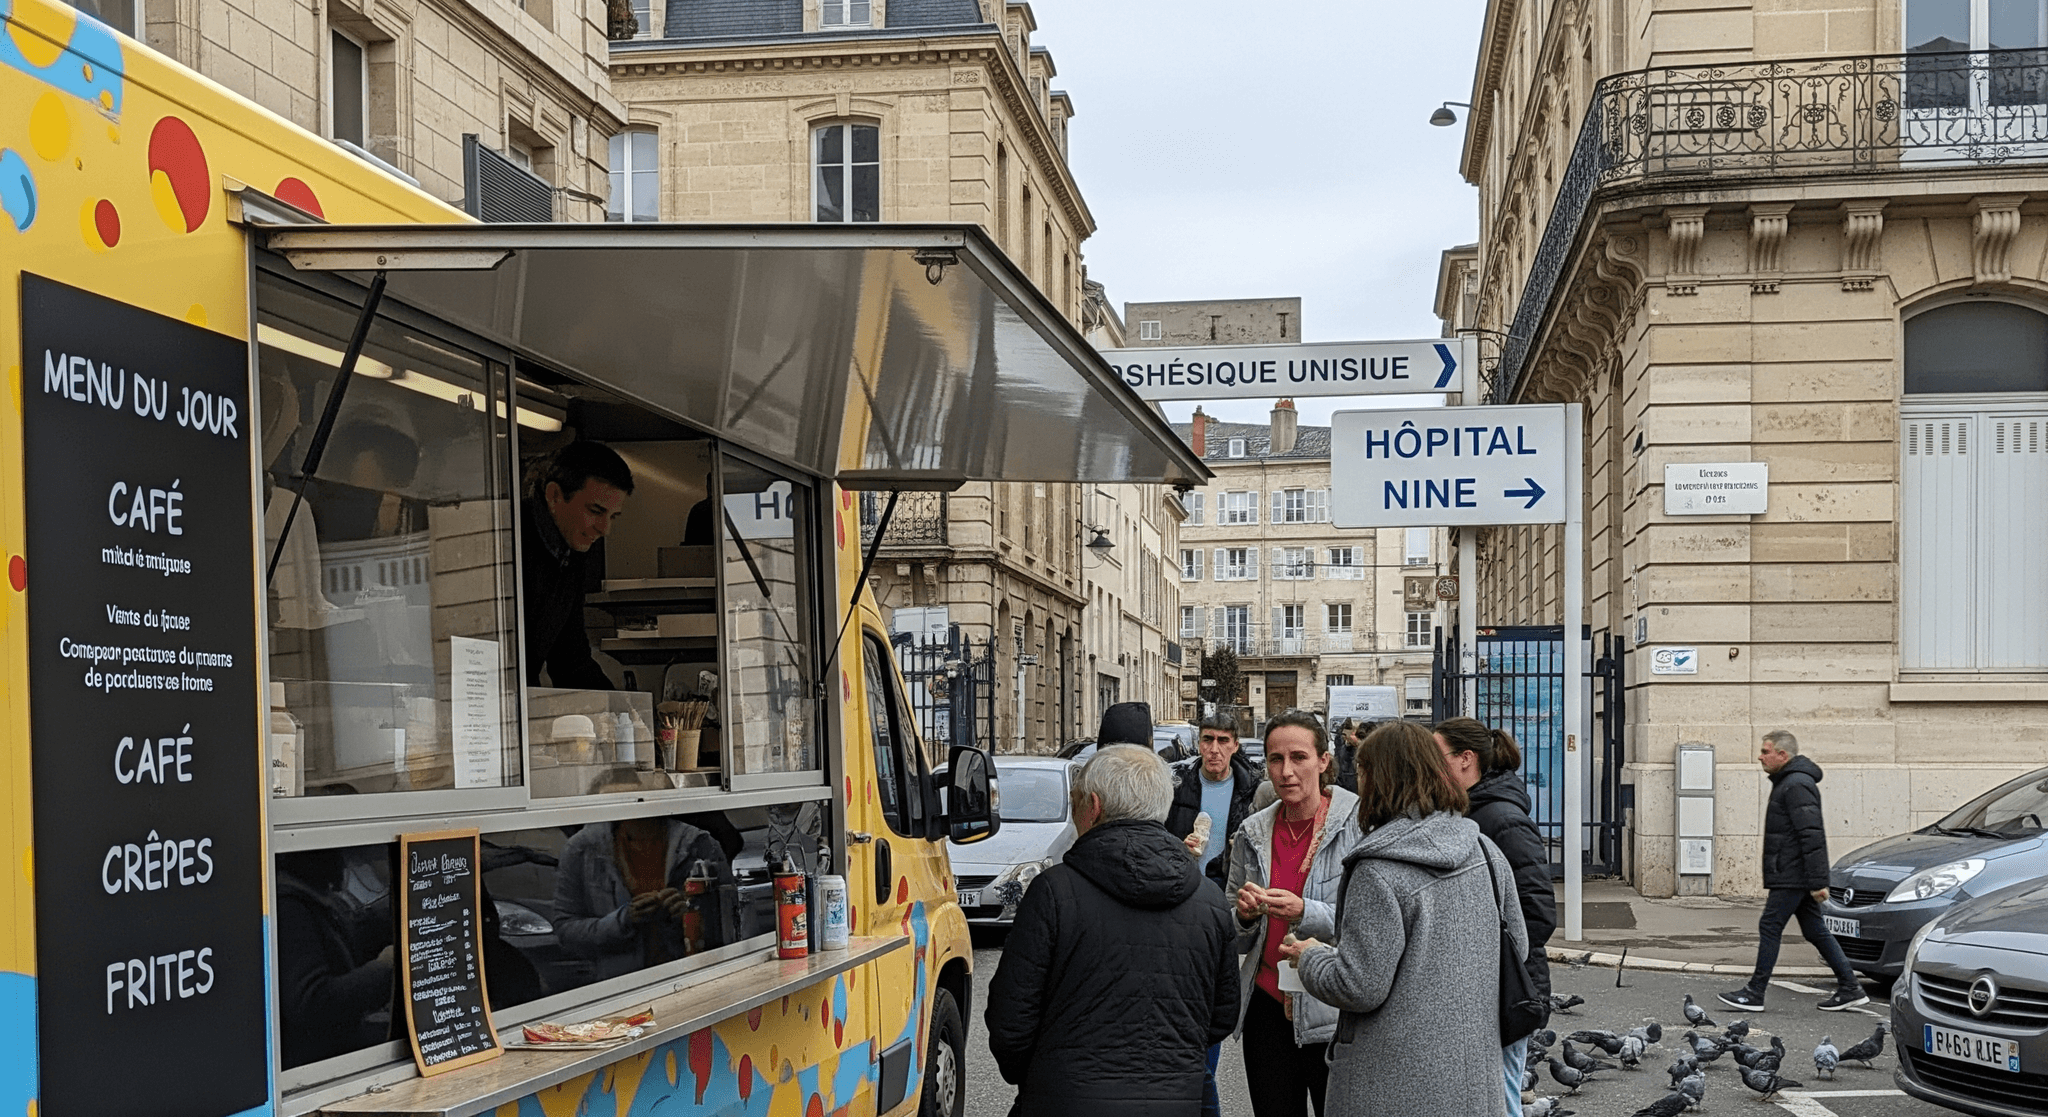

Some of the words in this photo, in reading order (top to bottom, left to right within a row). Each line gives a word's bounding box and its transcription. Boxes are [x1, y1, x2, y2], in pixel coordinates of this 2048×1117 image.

[1288, 356, 1410, 383] UNISIUE
[44, 348, 125, 410] MENU
[133, 372, 168, 421] DU
[176, 386, 238, 439] JOUR
[1366, 421, 1537, 459] HÔPITAL
[108, 478, 184, 536] CAFÉ
[1384, 478, 1477, 510] NINE
[143, 608, 159, 628] du
[178, 646, 195, 665] du
[84, 666, 103, 687] de
[114, 722, 194, 785] CAFÉ
[102, 829, 214, 895] CRÊPES
[106, 946, 215, 1015] FRITES
